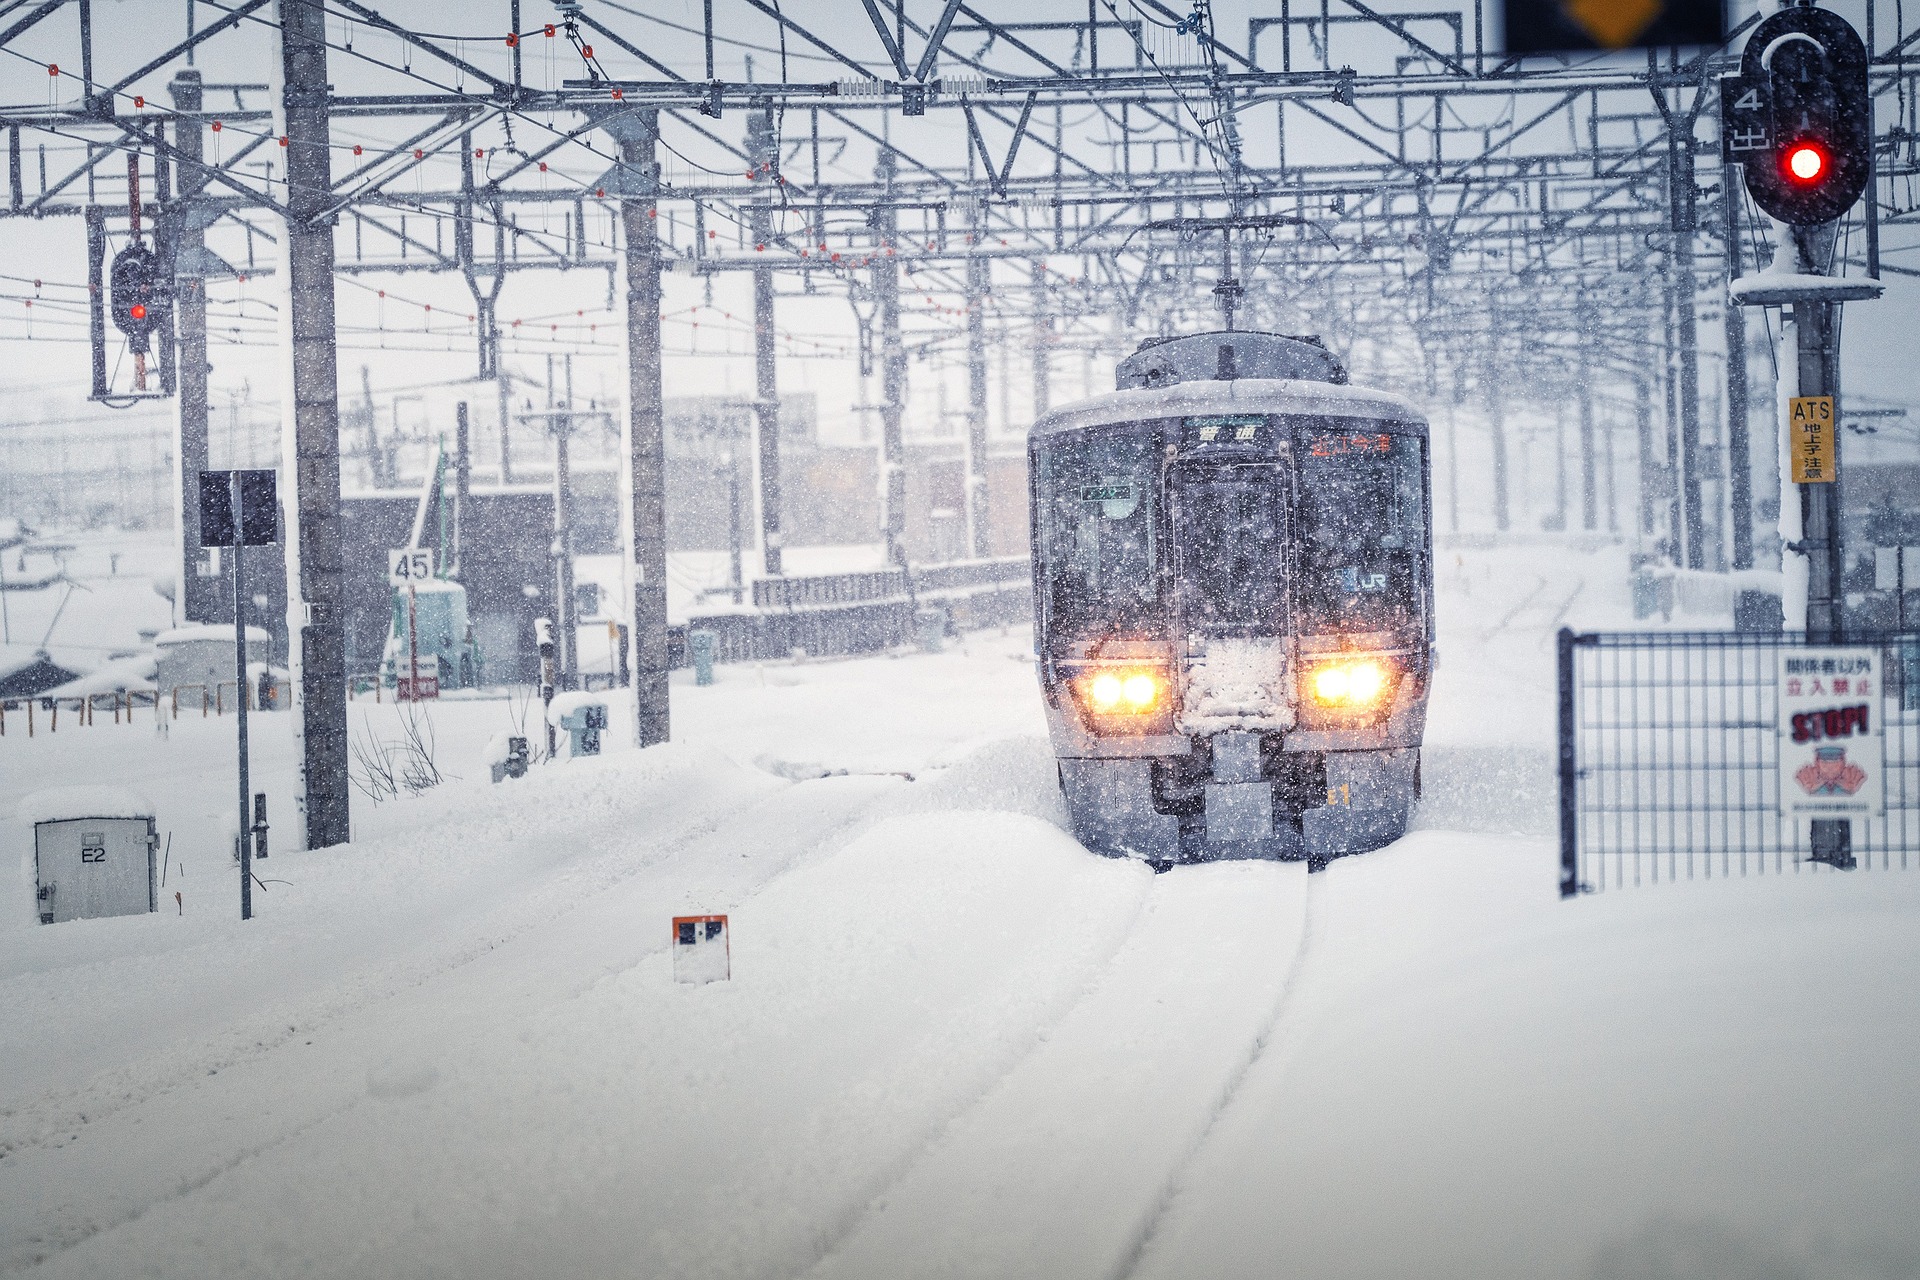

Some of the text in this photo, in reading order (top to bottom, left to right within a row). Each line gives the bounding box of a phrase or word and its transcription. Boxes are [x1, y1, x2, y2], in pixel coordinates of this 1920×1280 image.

[1793, 401, 1830, 420] ATS
[395, 554, 428, 580] 45
[1361, 574, 1386, 589] JR
[1787, 678, 1871, 697] 立入禁止
[82, 848, 105, 863] E2
